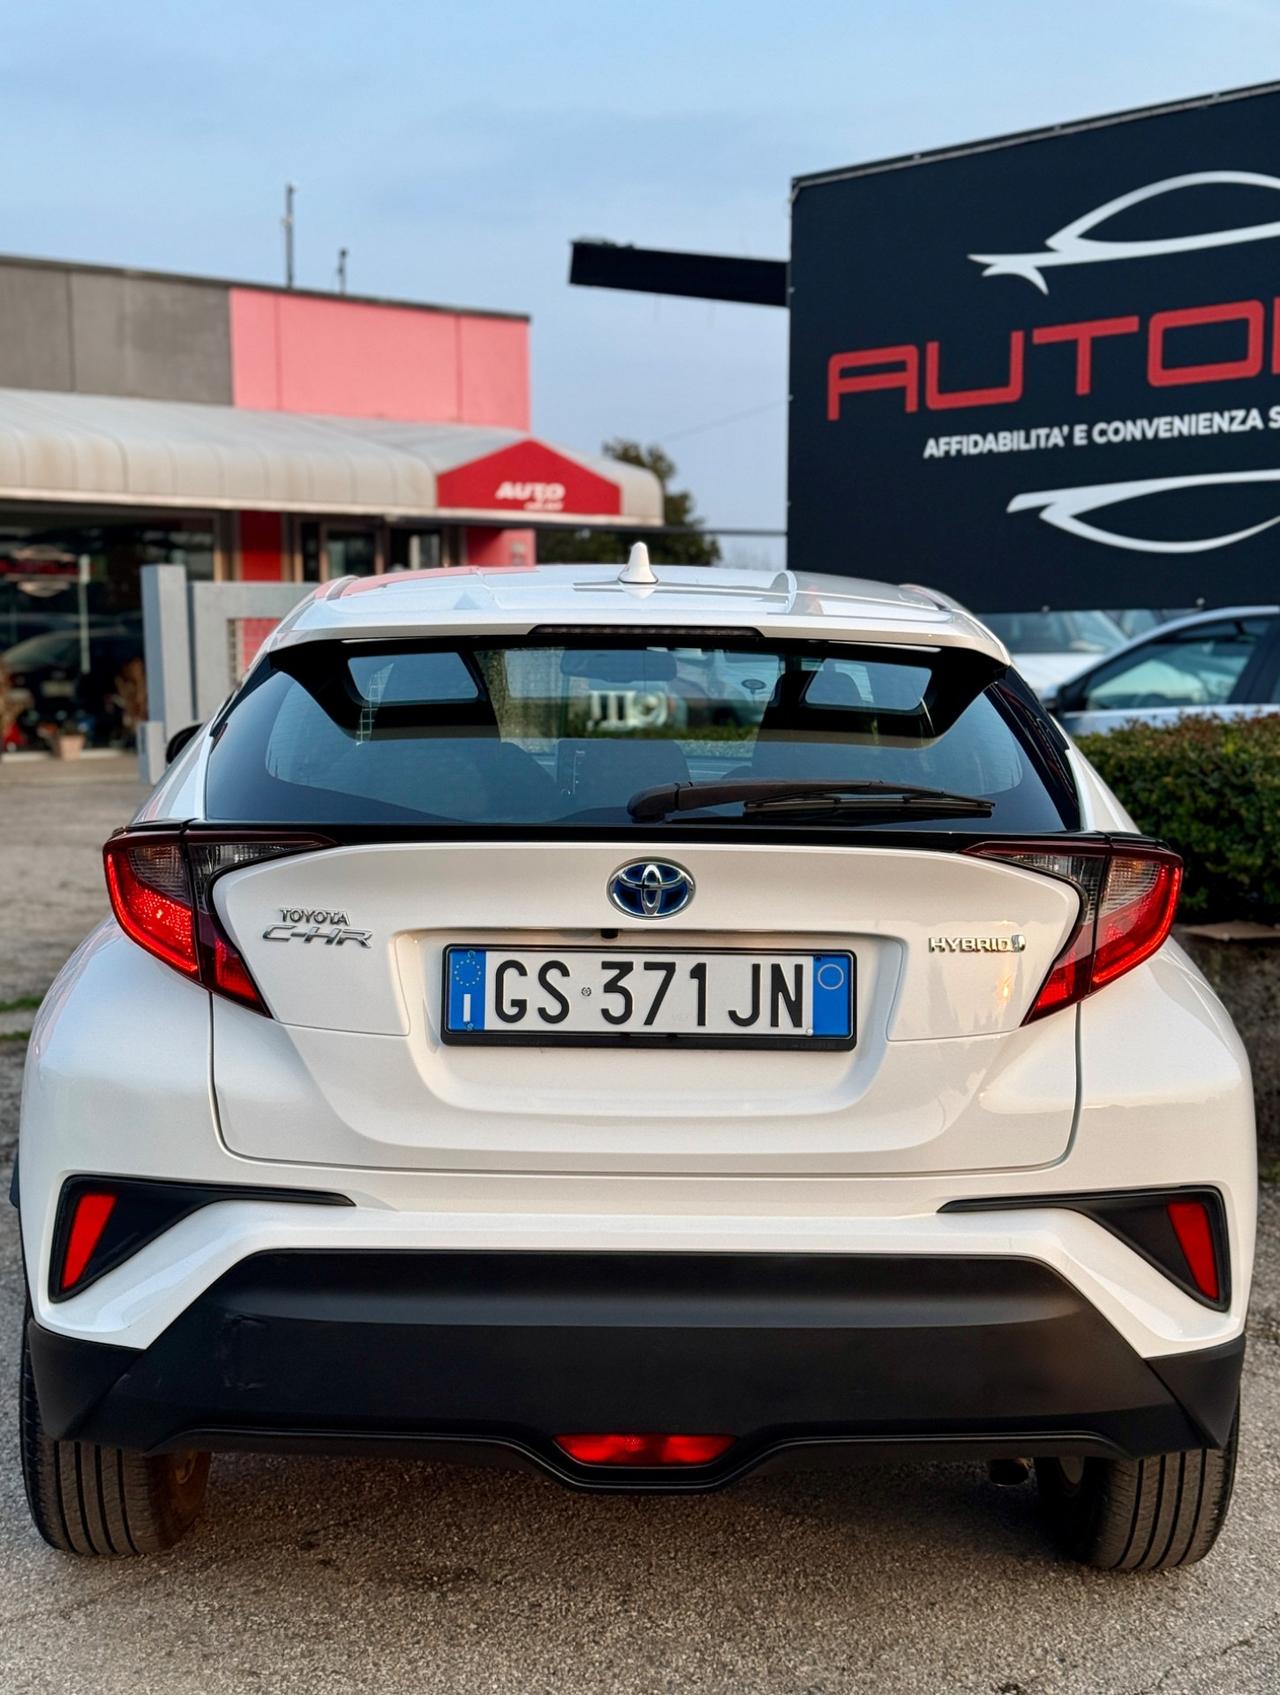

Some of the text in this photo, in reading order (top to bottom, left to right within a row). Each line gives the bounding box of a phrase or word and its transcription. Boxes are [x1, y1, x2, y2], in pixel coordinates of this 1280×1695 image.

[827, 296, 1280, 421] AUTO
[923, 424, 1069, 459] AFFIDABILITA'
[1073, 424, 1088, 446] E
[1092, 408, 1264, 445] CONVENIENZA
[280, 908, 349, 926] TOYOTA
[262, 924, 372, 948] C-HR
[928, 937, 1011, 953] HYBRID
[495, 960, 571, 1025] GS
[600, 961, 707, 1027] 371
[728, 963, 804, 1029] JN
